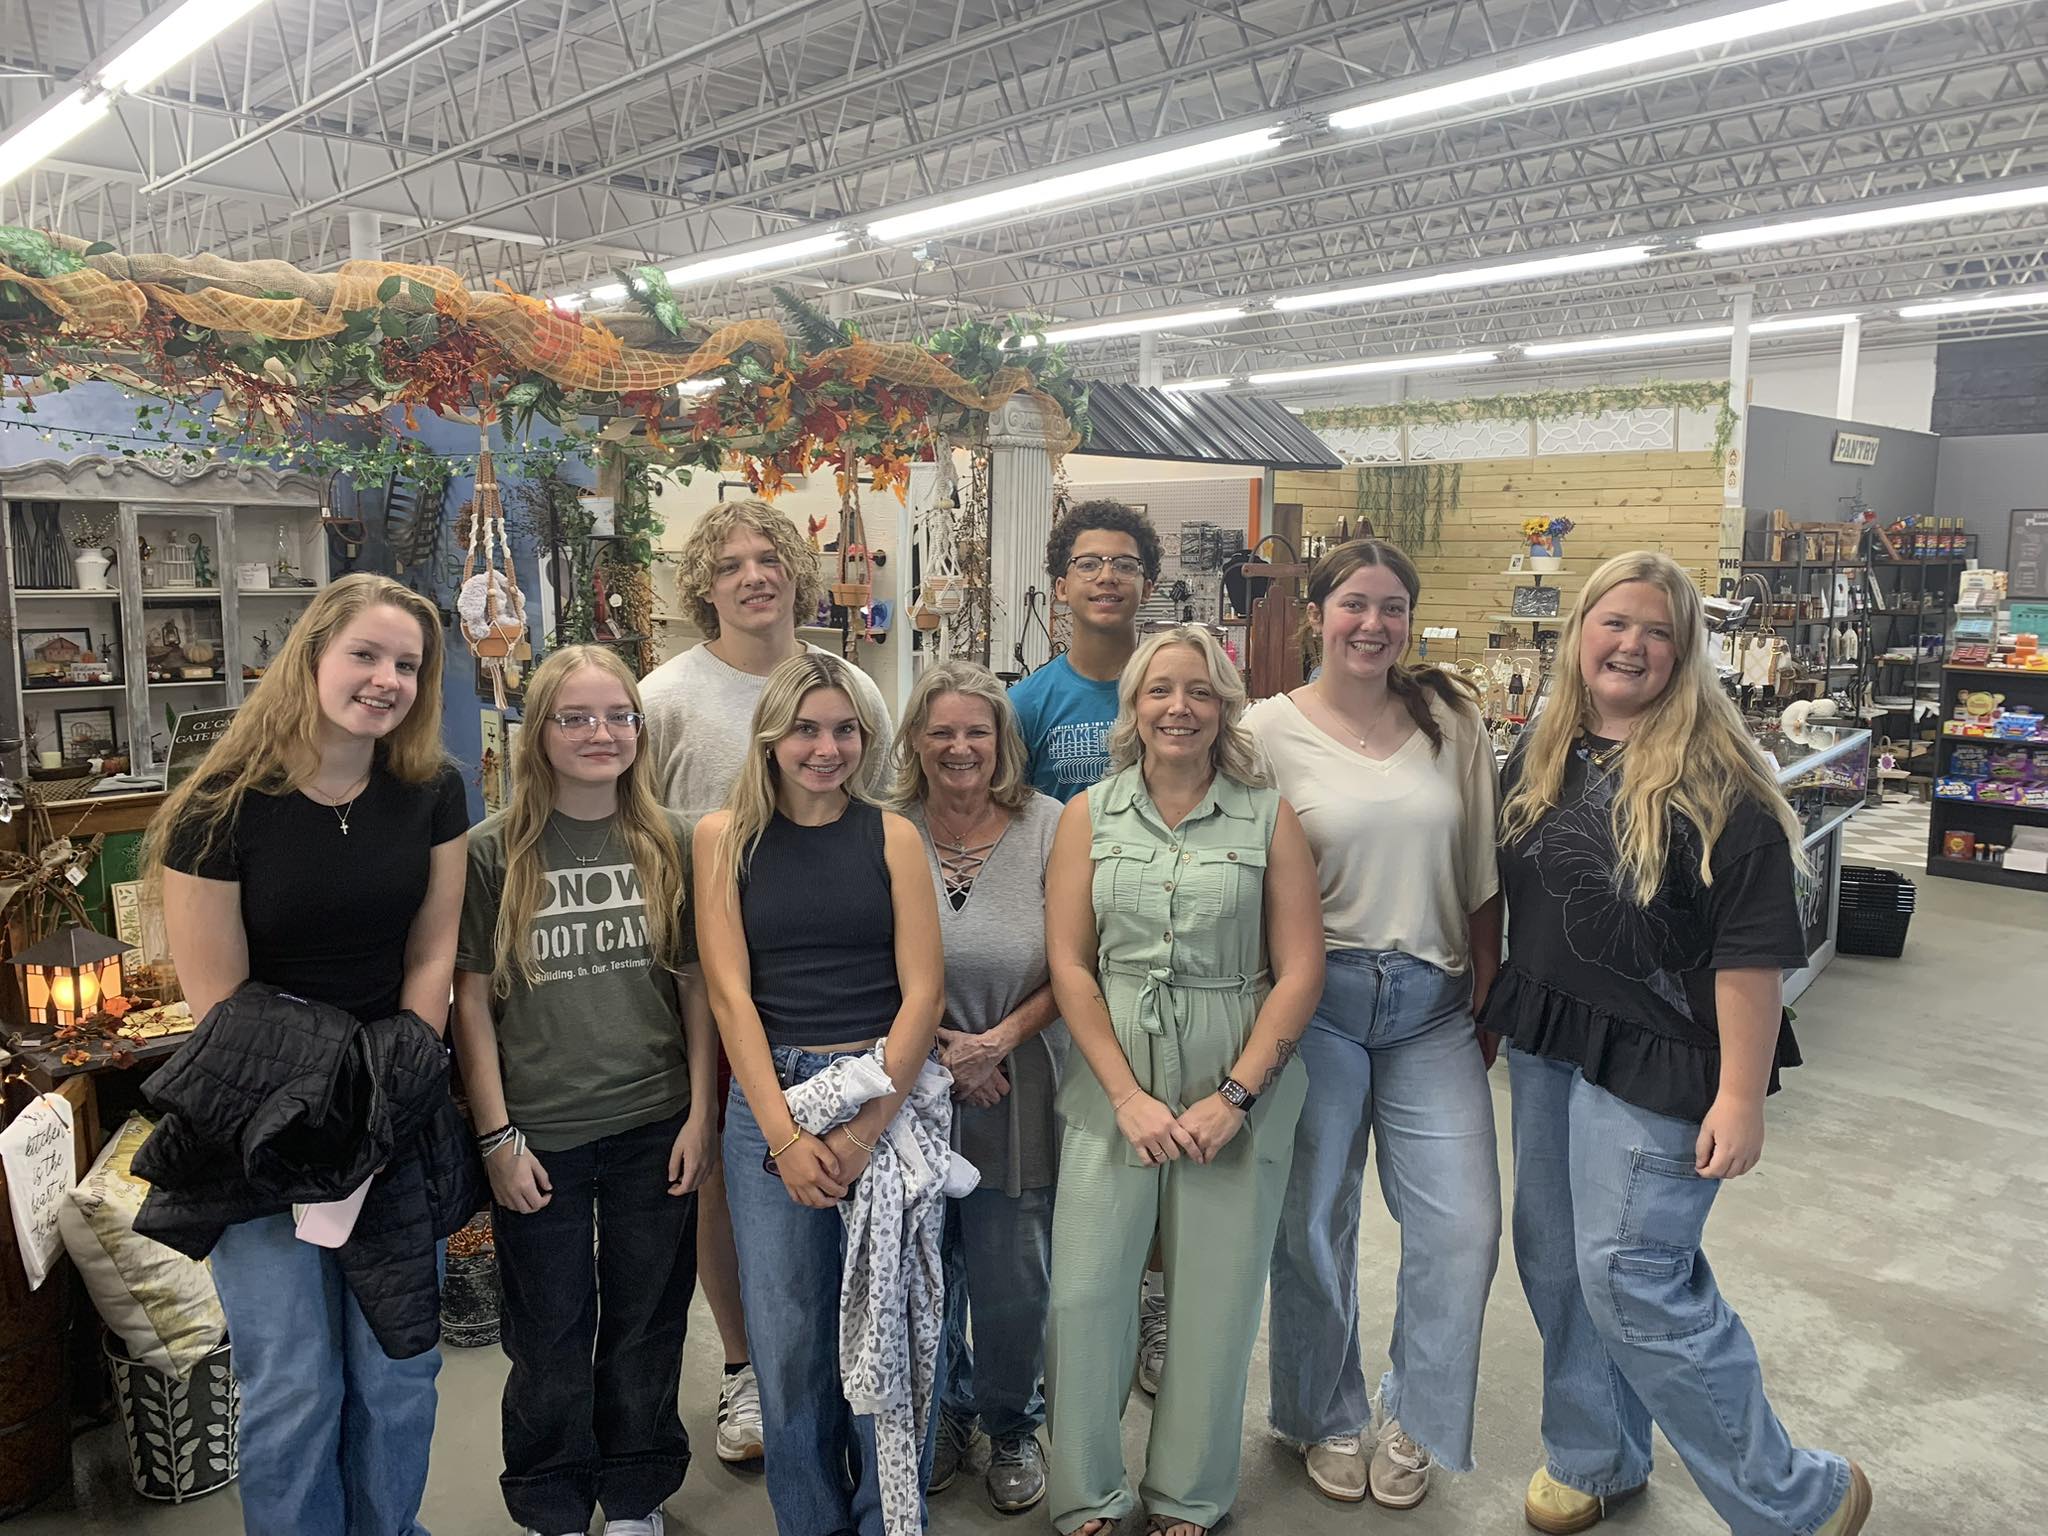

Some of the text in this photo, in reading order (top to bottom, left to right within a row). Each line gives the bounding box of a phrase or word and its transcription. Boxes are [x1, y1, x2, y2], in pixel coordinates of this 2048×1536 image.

[1837, 437, 1878, 462] PANTRY
[1718, 558, 1740, 569] THE
[175, 731, 210, 744] GATE
